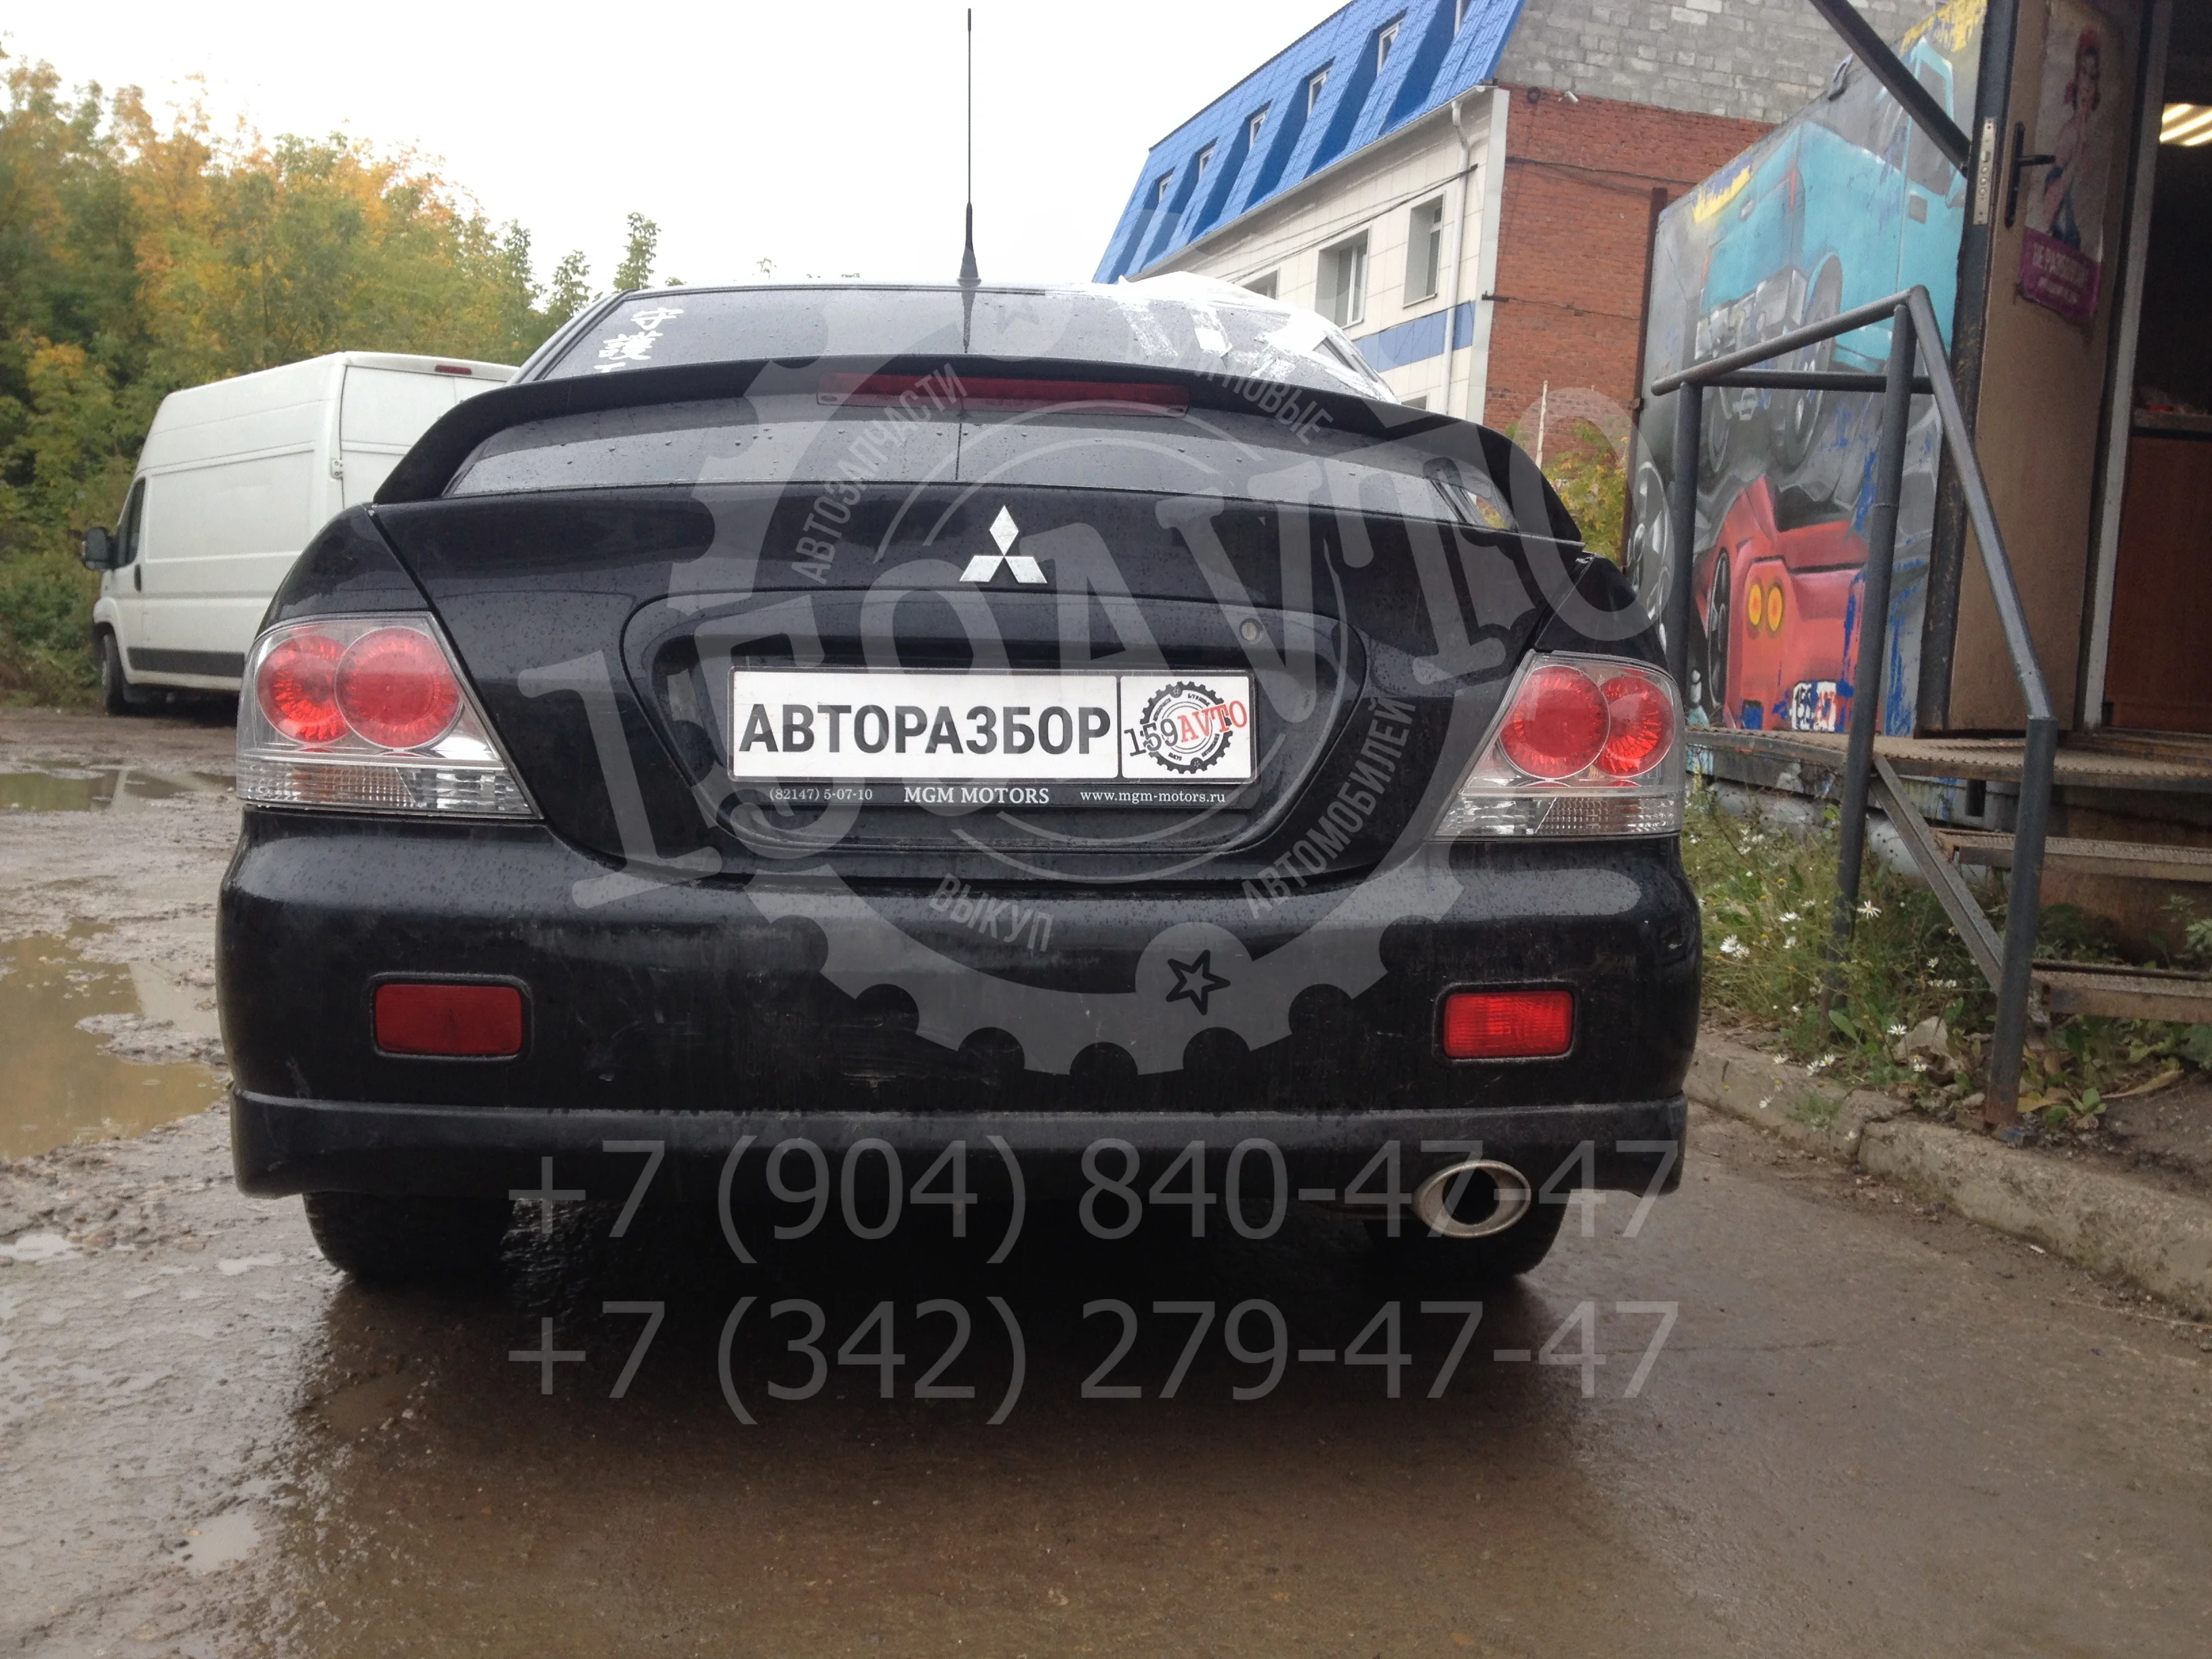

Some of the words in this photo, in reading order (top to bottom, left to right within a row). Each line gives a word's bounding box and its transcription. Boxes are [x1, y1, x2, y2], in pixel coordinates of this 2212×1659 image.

[739, 703, 1111, 755] АВТОРАЗБОР
[1124, 700, 1248, 757] 159AVTO
[769, 787, 820, 802] (82147)
[823, 788, 873, 801] 5-07-10
[904, 787, 954, 803] MGM
[960, 787, 1050, 804] MOTORS
[1080, 789, 1226, 805] www.mgm-motors.ru
